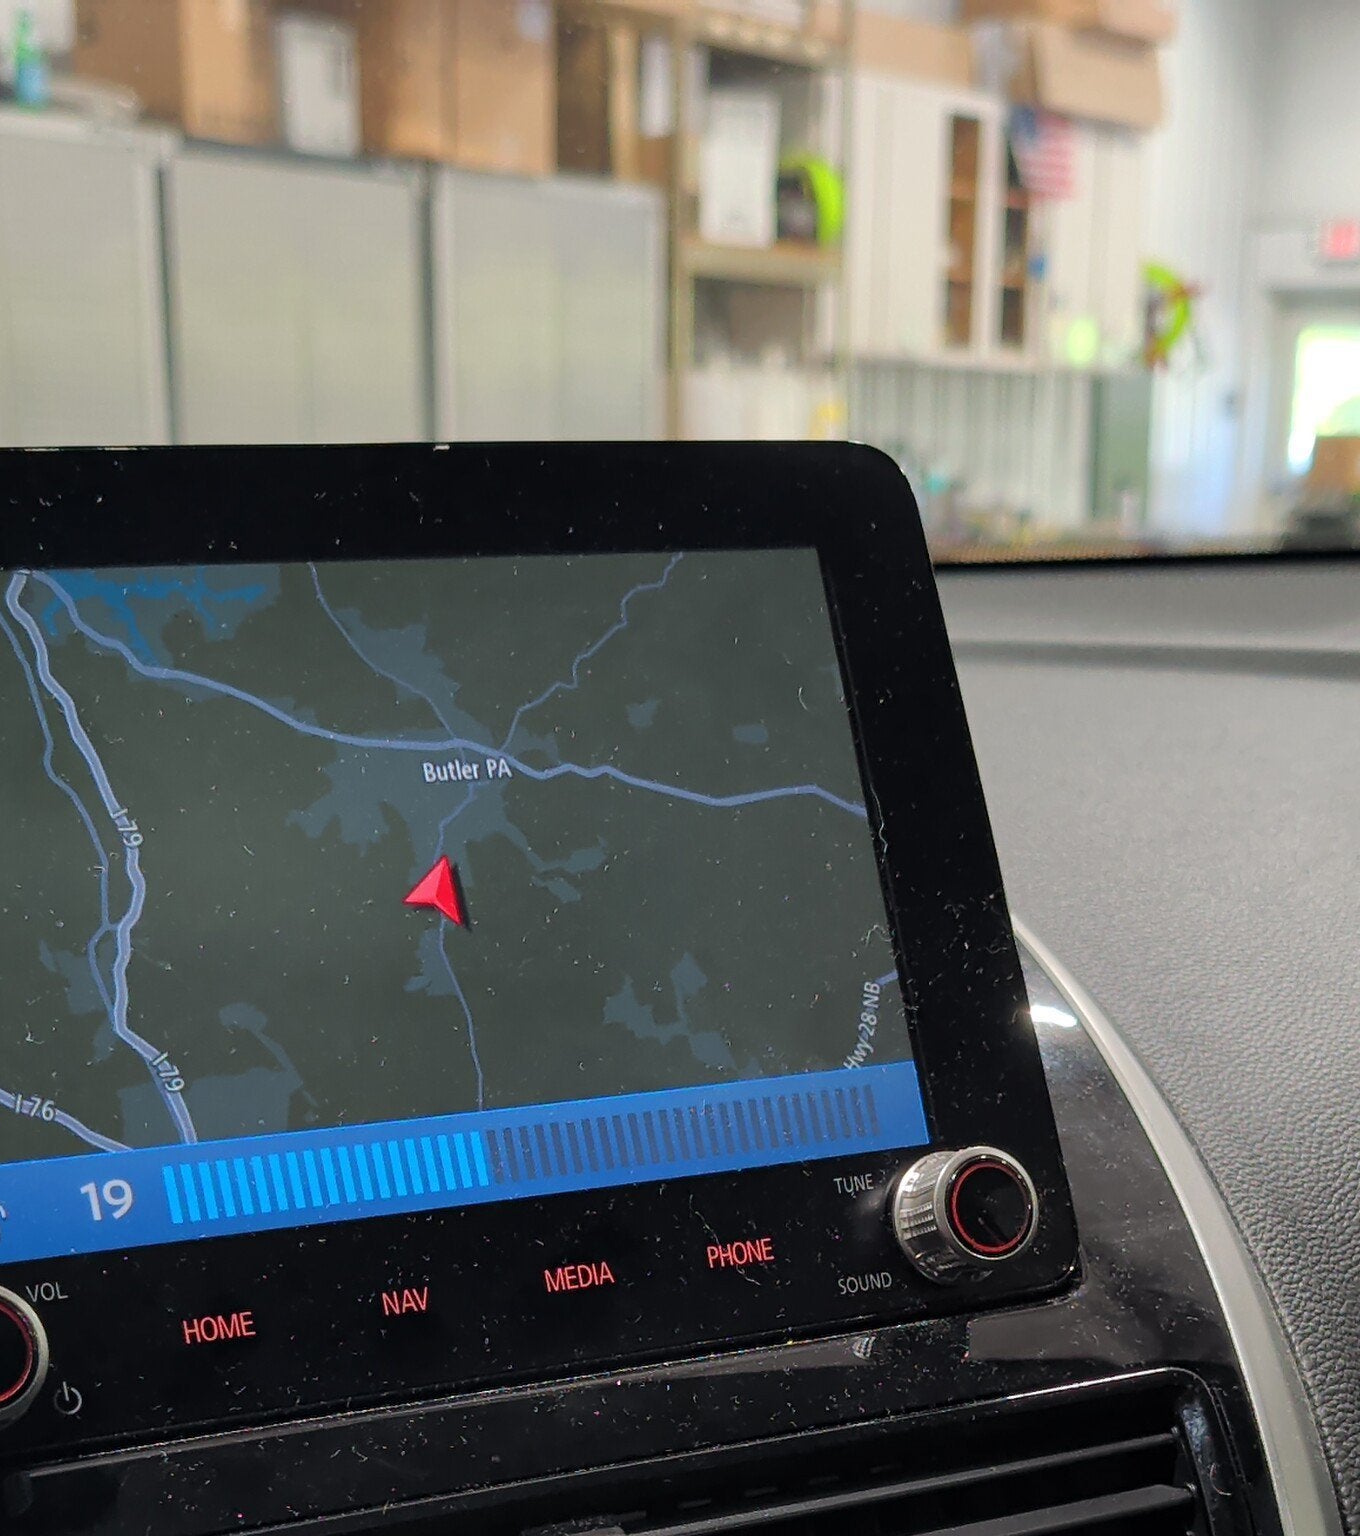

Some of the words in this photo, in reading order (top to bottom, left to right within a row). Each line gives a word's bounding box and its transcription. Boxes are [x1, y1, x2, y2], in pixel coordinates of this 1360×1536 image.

[422, 758, 480, 783] Butler
[485, 757, 513, 779] PA
[117, 818, 144, 848] 79
[862, 980, 881, 1009] NB
[858, 1011, 877, 1037] 28
[843, 1034, 875, 1070] Hwy
[158, 1064, 185, 1091] 79
[29, 1095, 55, 1121] 76
[833, 1172, 875, 1194] TUNE
[79, 1179, 133, 1221] 19
[706, 1237, 776, 1269] PHONE
[544, 1261, 616, 1293] MEDIA
[837, 1270, 892, 1295] SOUND
[25, 1281, 69, 1303] VOL
[382, 1286, 429, 1316] NAV
[182, 1311, 257, 1345] HOME
